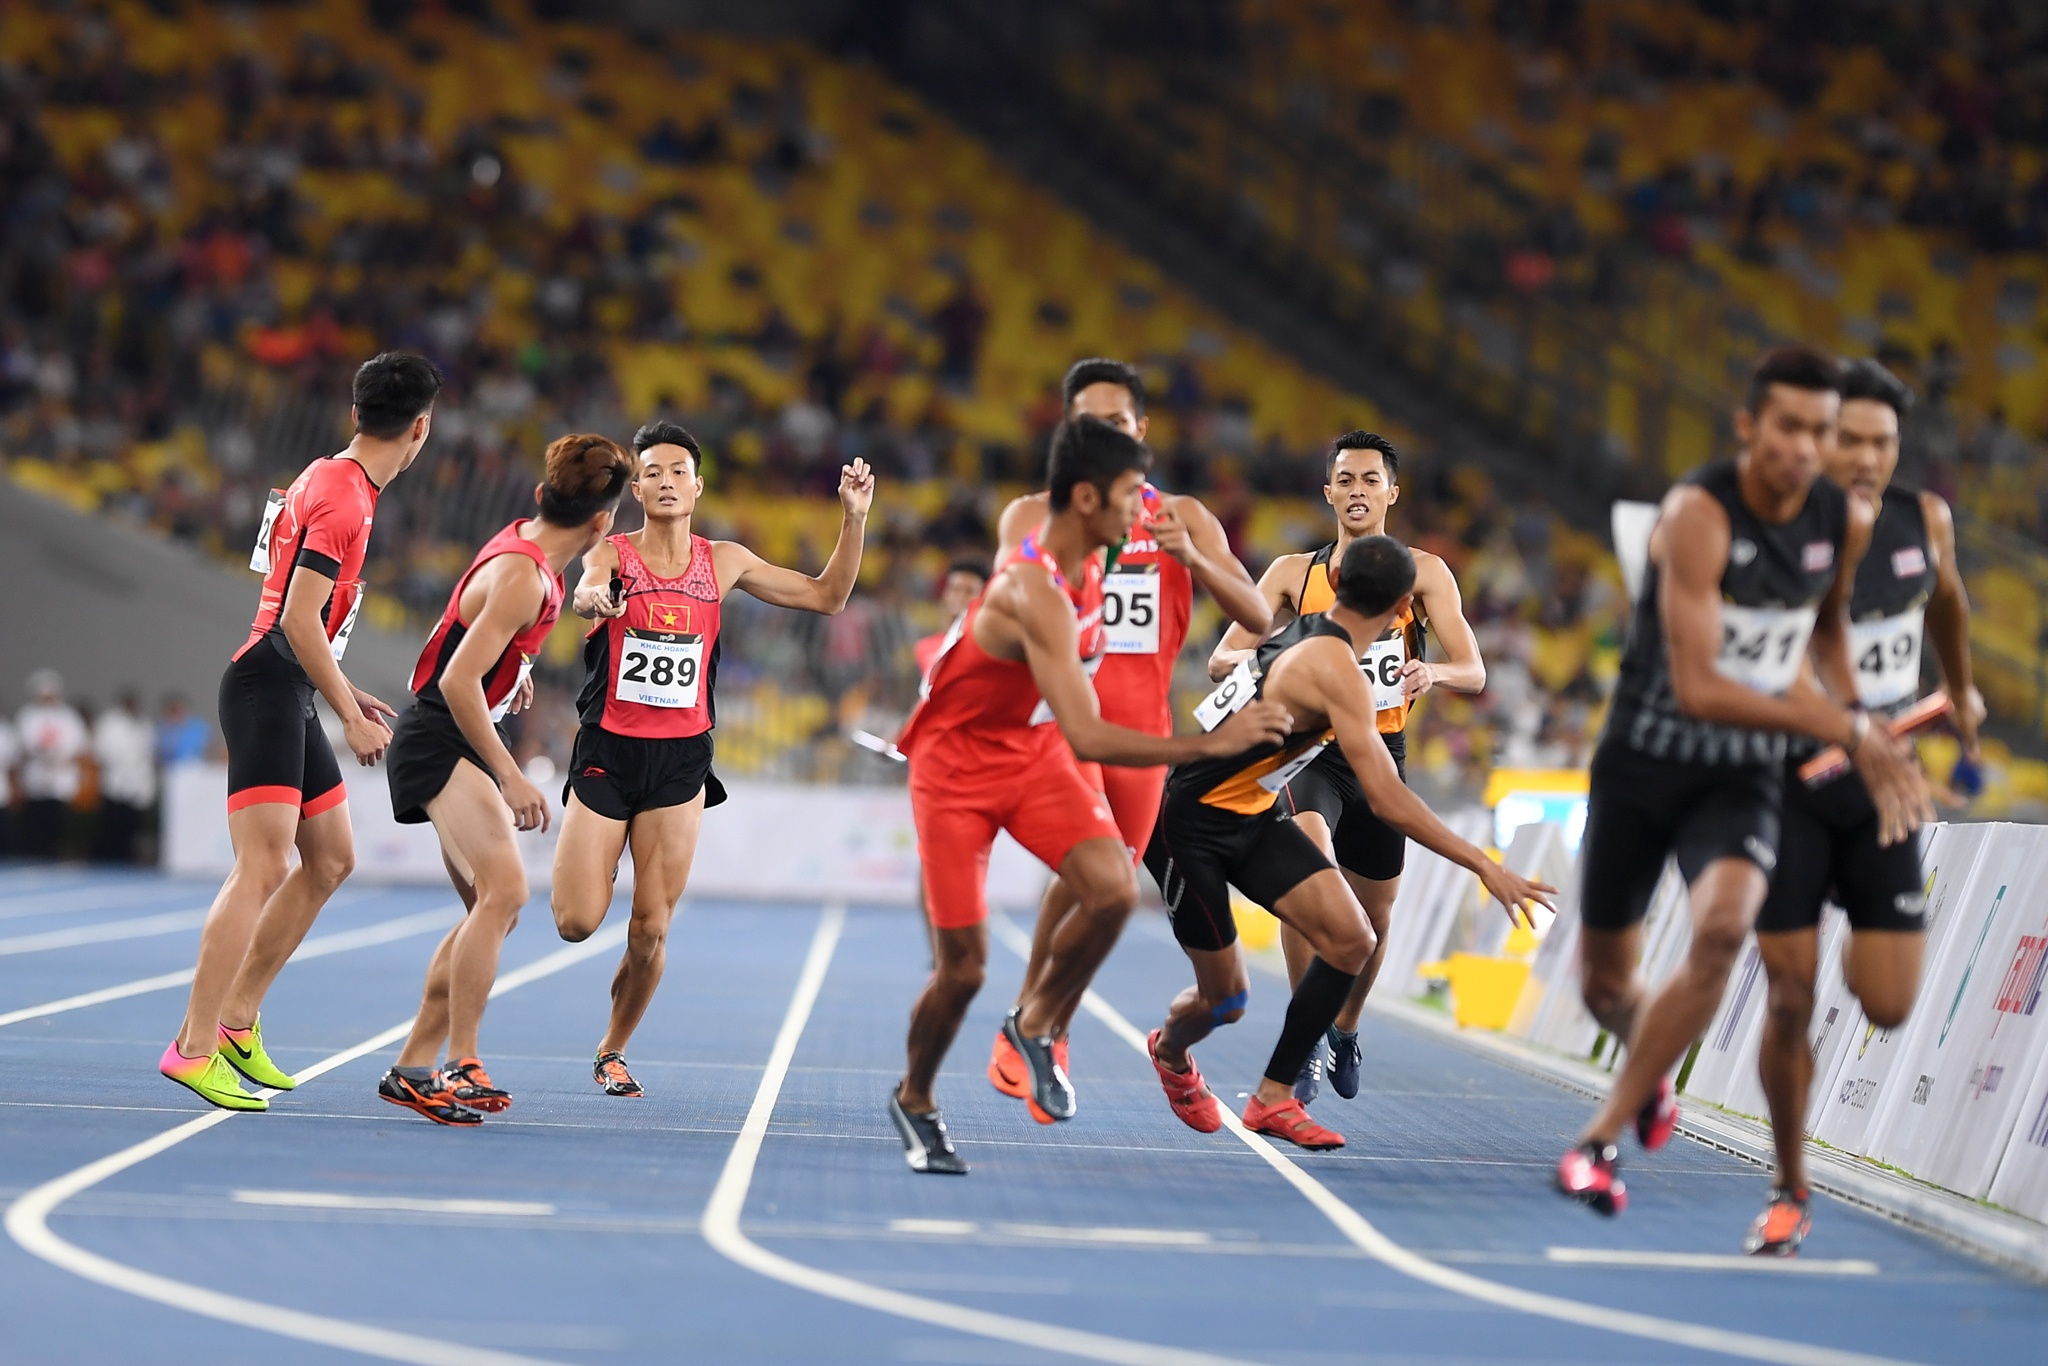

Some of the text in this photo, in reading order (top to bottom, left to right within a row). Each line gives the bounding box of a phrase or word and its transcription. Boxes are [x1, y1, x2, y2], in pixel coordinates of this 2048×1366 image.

[640, 642, 689, 653] KHAC HOANG
[622, 651, 696, 688] 289
[638, 693, 679, 705] VIETNAM
